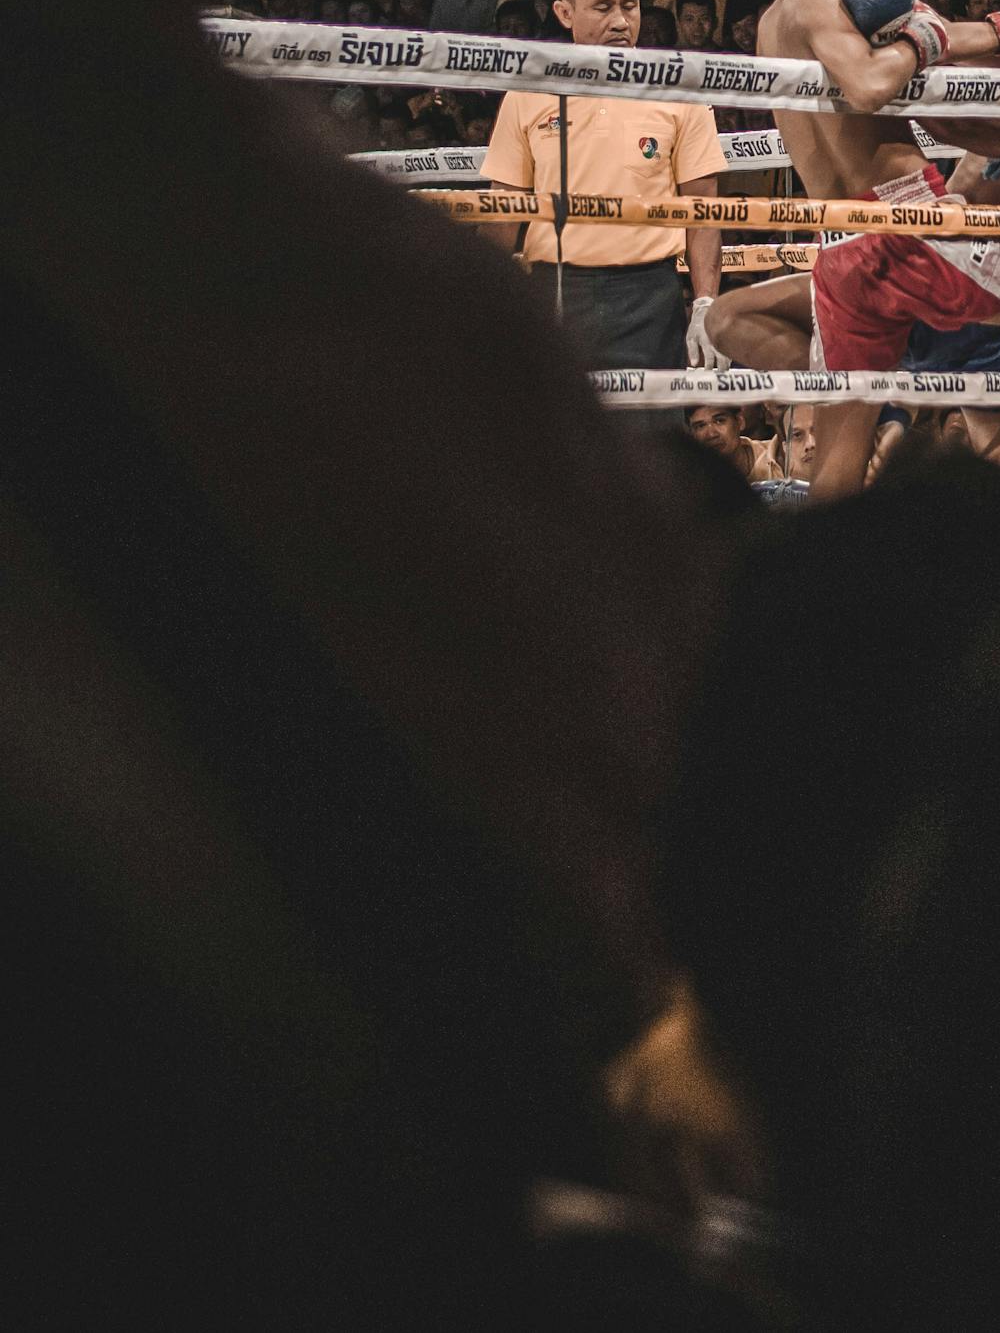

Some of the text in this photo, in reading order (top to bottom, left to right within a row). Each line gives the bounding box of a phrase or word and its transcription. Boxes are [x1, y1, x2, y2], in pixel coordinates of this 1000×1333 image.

[445, 46, 529, 74] REGENCY
[700, 67, 779, 93] REGENCY
[768, 202, 827, 224] REGENCY
[794, 372, 851, 391] REGENCY
